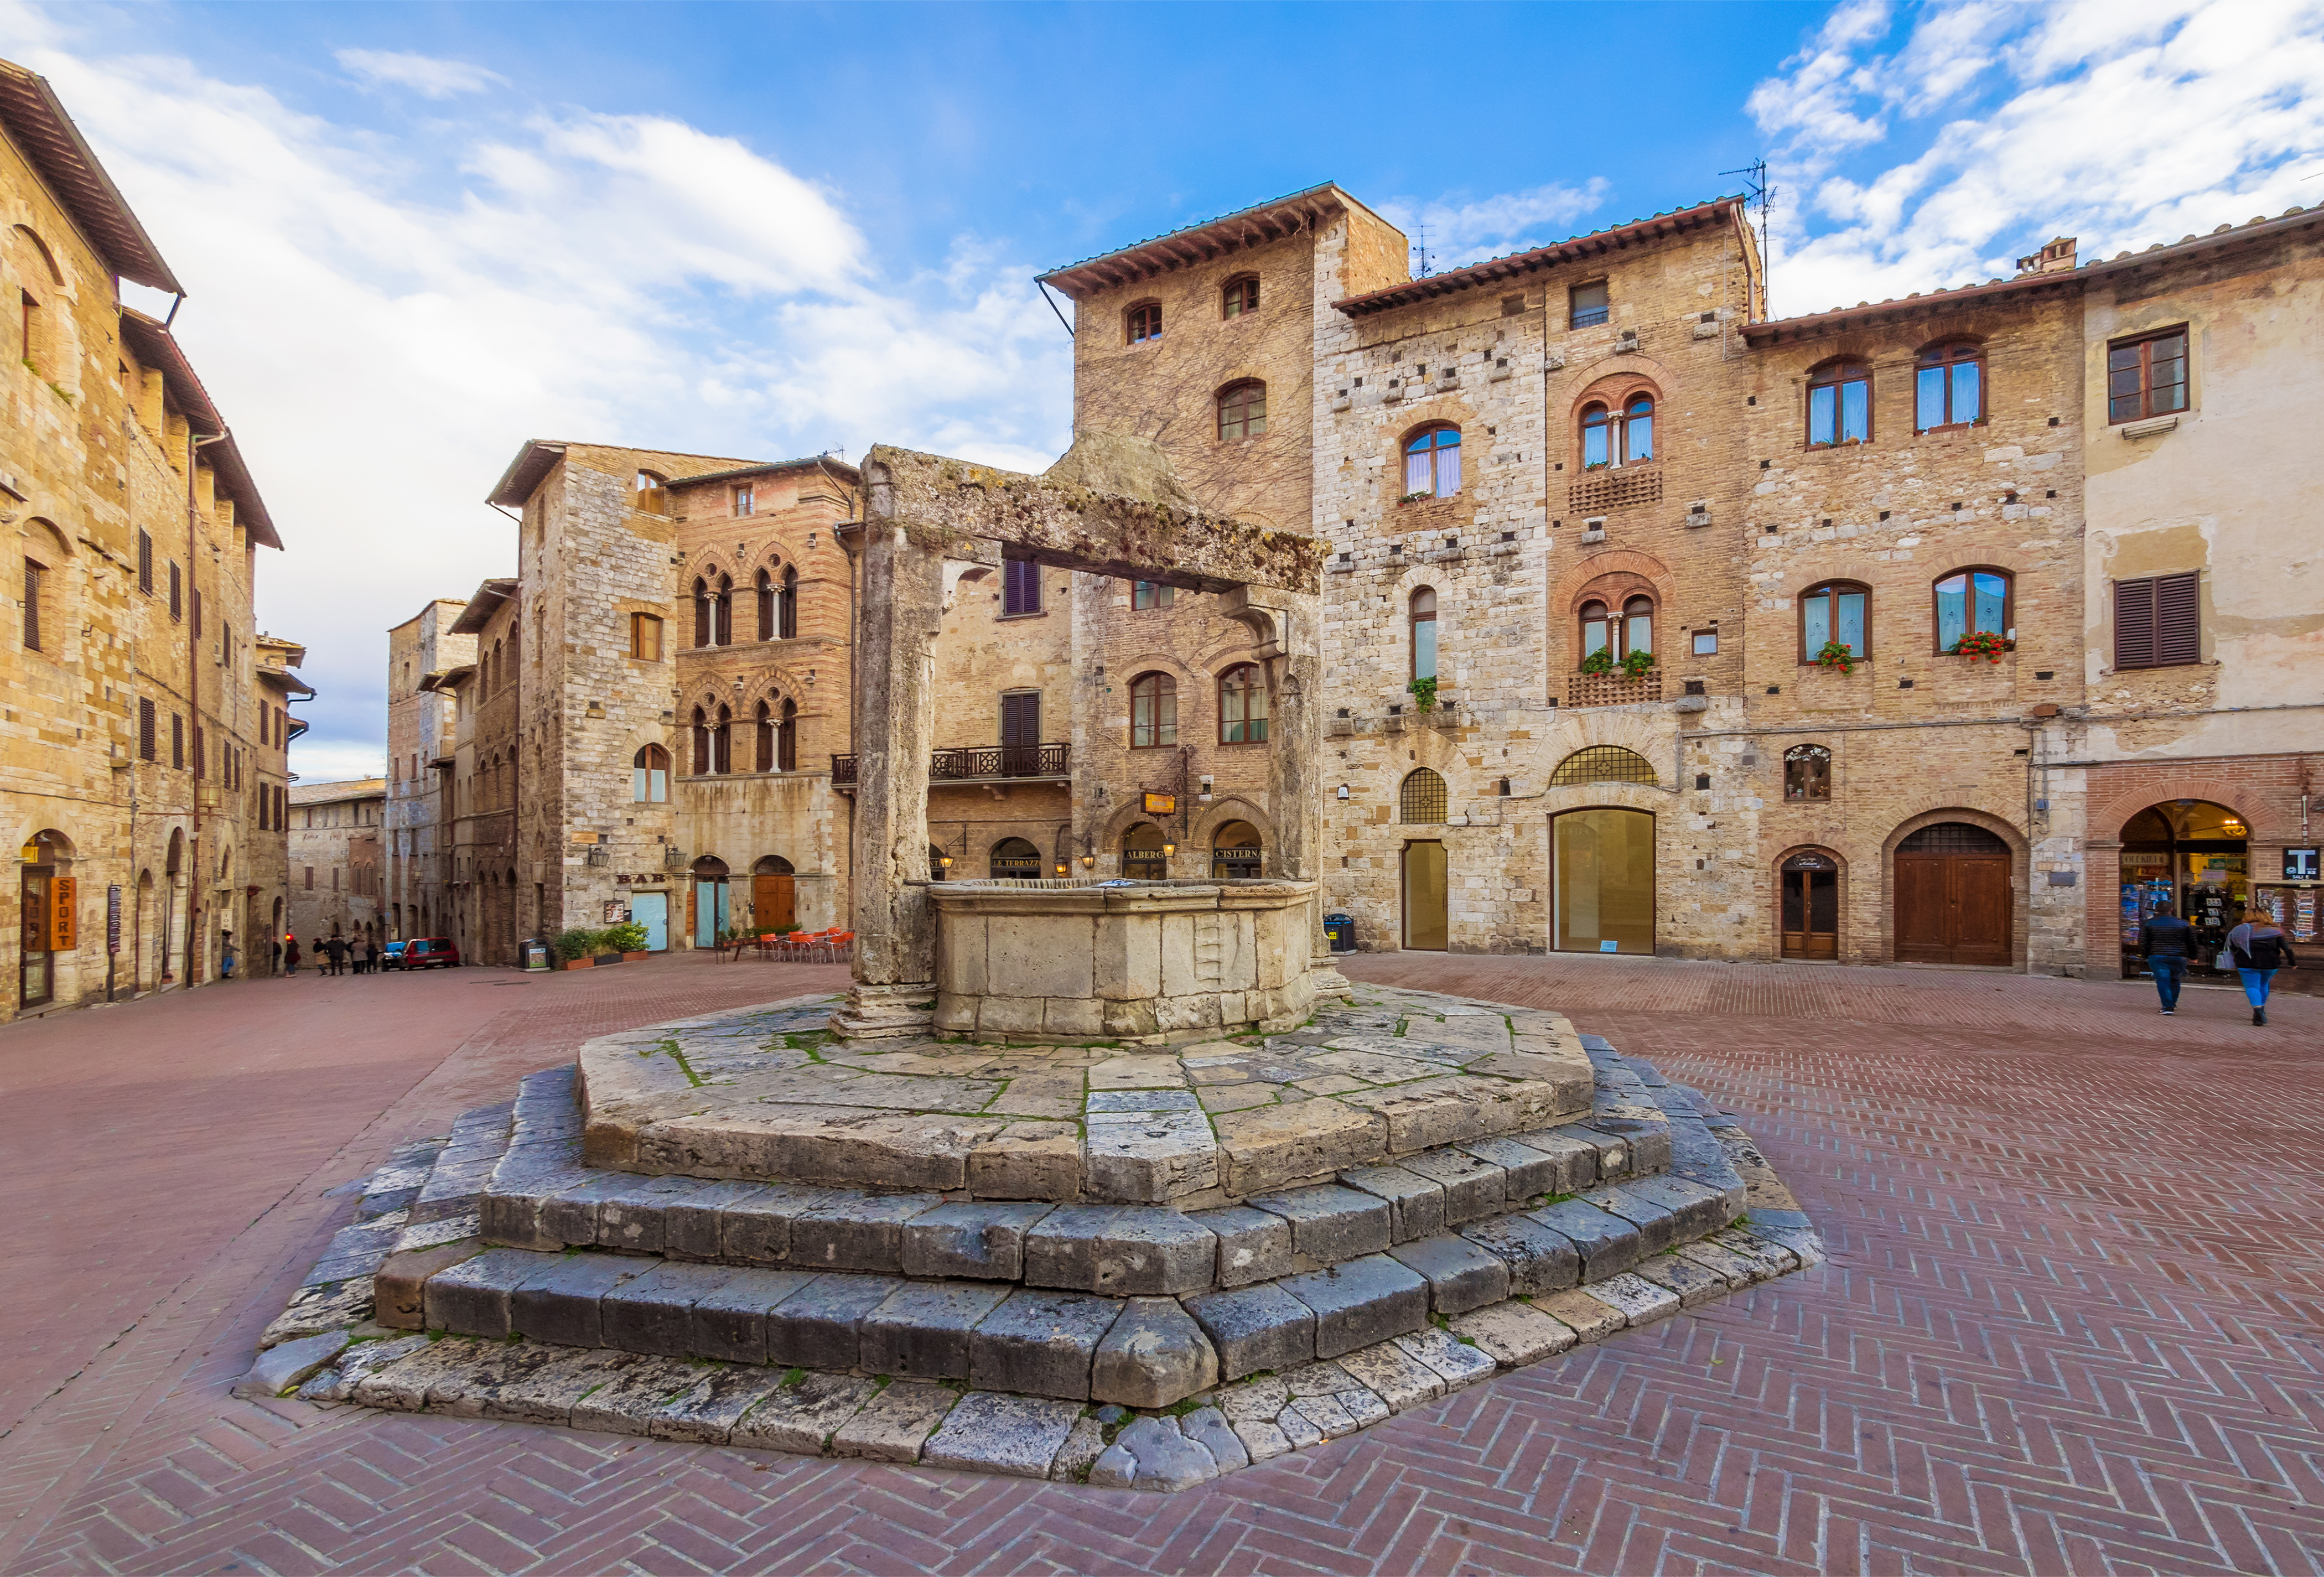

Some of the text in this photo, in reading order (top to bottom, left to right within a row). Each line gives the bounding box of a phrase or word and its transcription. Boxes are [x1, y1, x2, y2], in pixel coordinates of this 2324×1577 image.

[1126, 850, 1164, 859] ALBERG
[2288, 850, 2316, 874] T
[616, 874, 666, 884] BAR
[58, 879, 70, 946] SPORT
